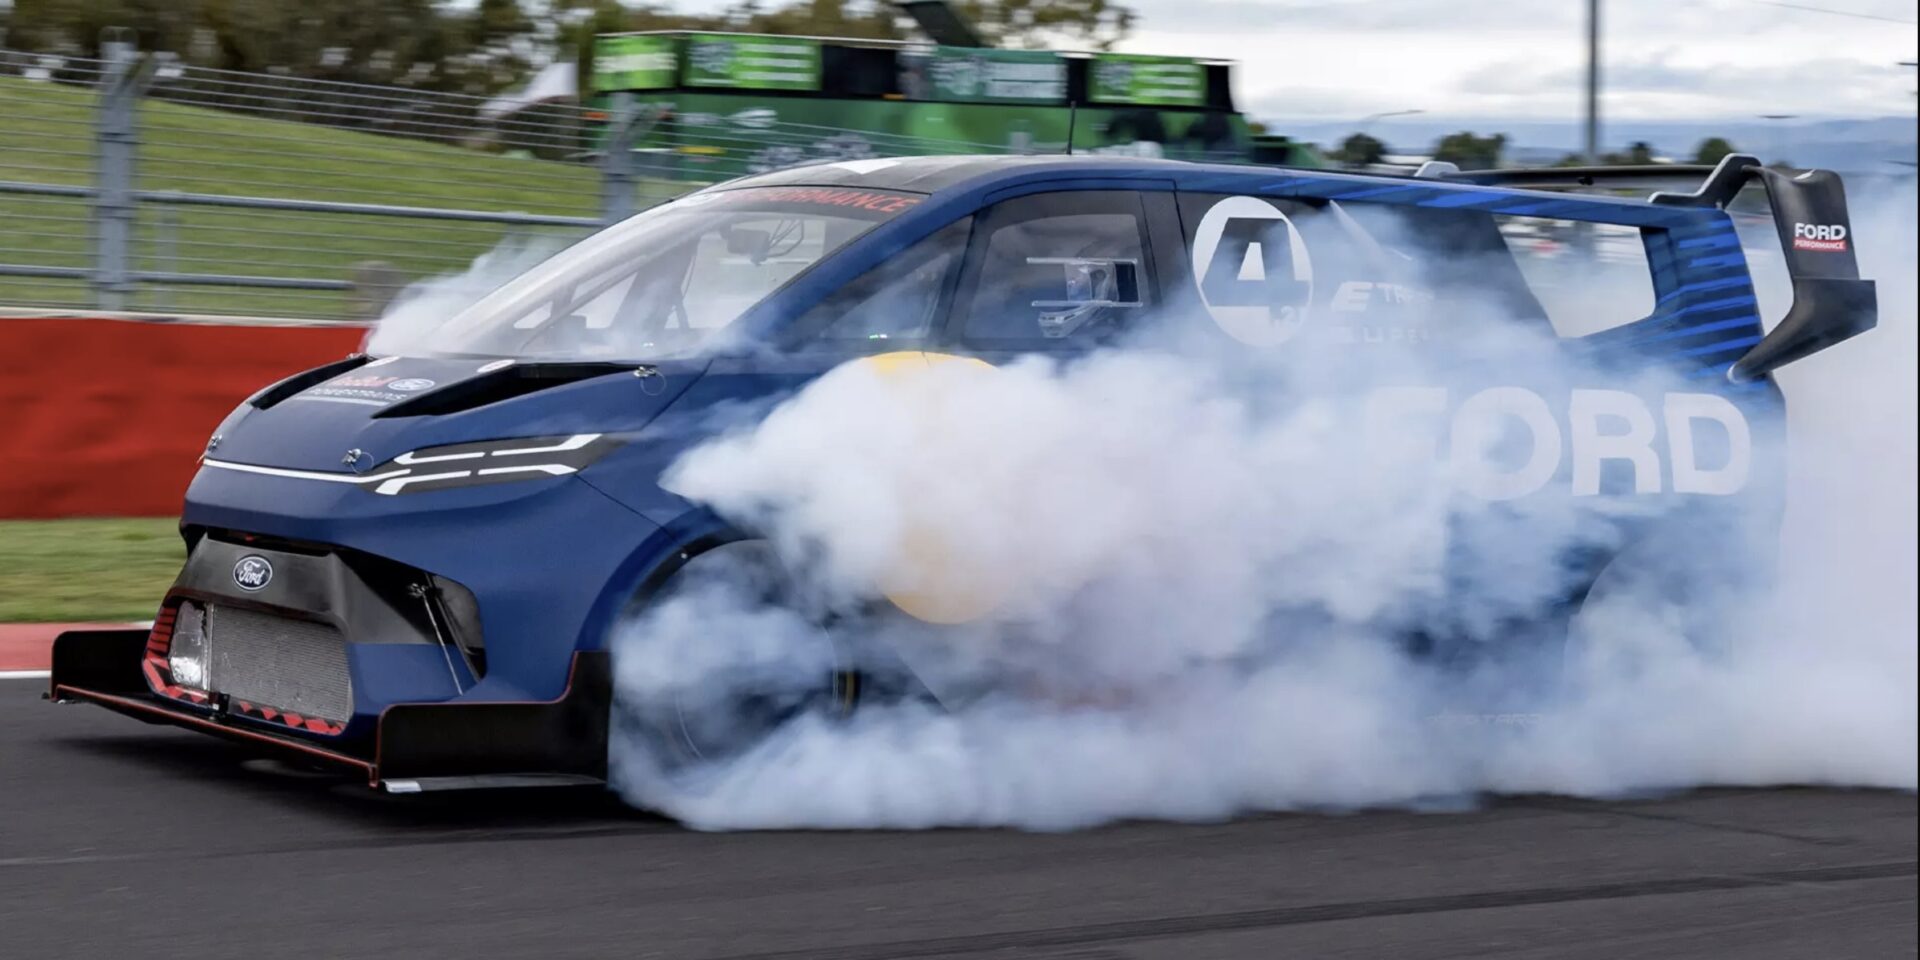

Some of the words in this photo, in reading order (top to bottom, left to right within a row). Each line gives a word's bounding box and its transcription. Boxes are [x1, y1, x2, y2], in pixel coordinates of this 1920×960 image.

[1794, 222, 1847, 240] FORD
[1369, 385, 1752, 500] FORD
[237, 558, 267, 587] Ford
